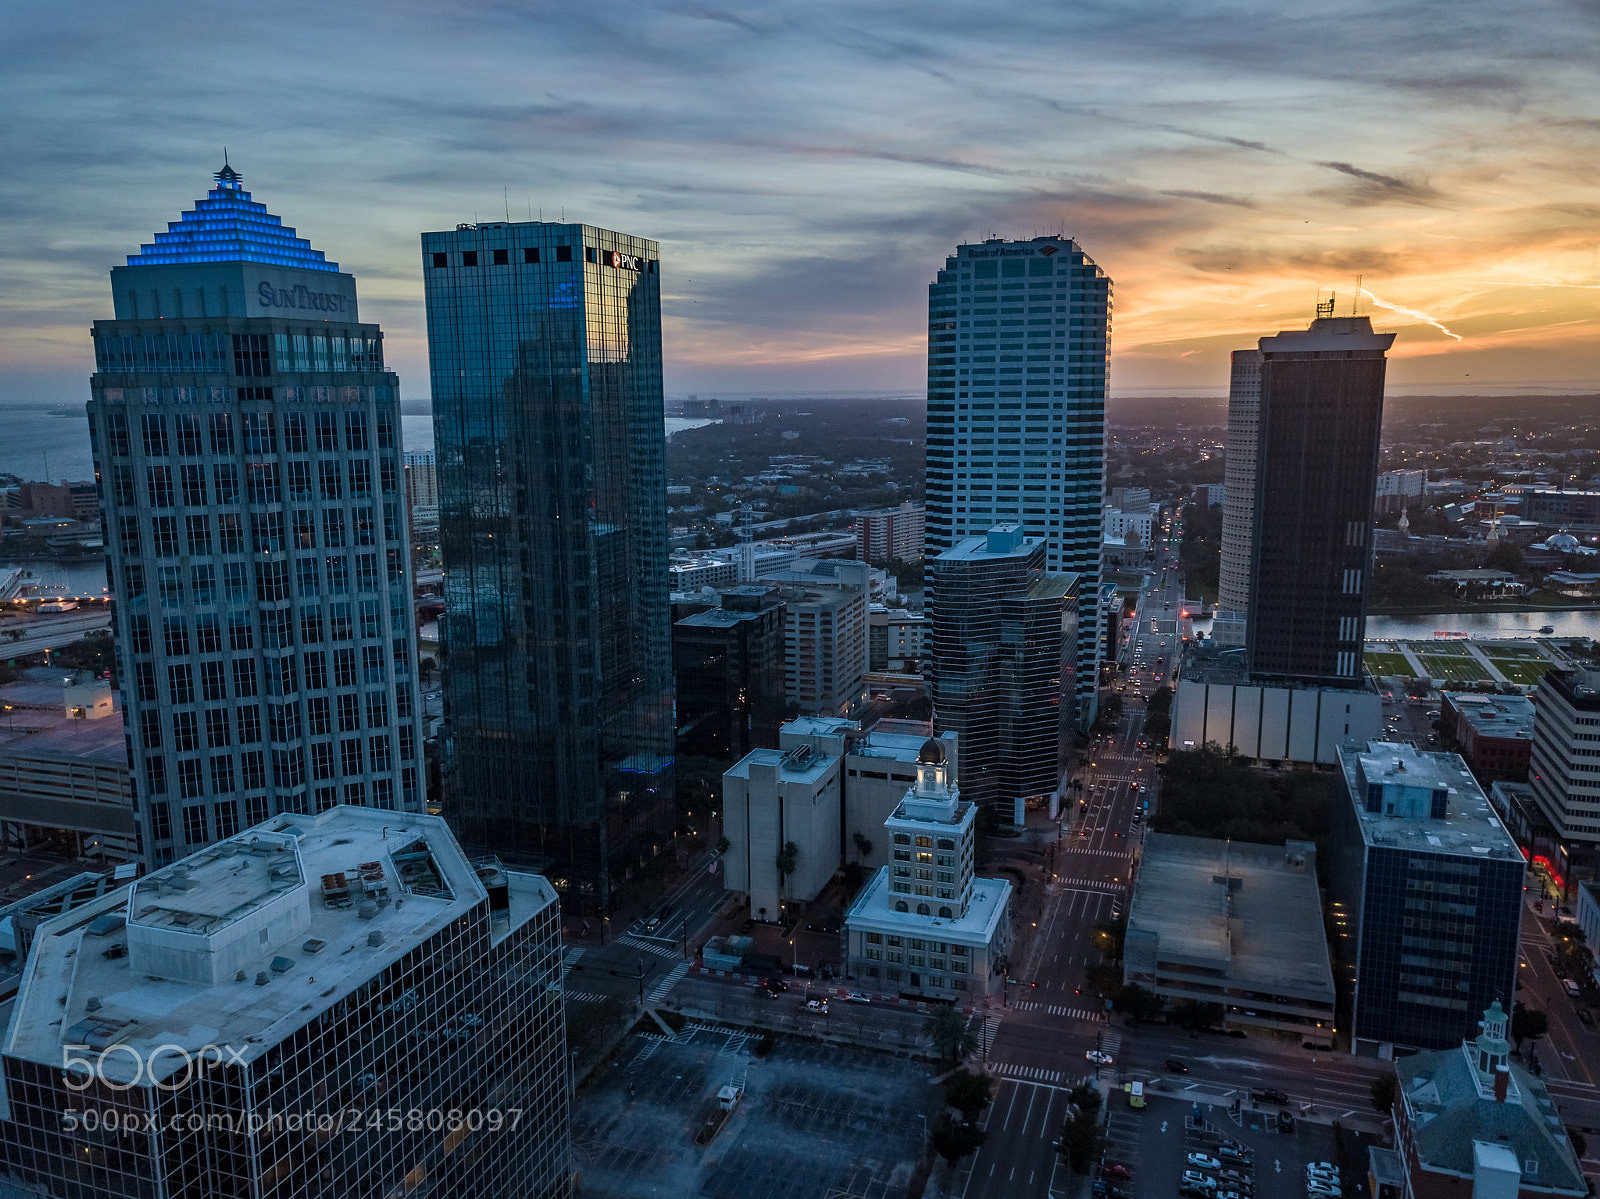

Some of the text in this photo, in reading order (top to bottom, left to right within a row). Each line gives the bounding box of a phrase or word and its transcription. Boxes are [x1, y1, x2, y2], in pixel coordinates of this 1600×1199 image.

[968, 247, 1035, 258] Bank of America
[621, 254, 639, 271] PNC
